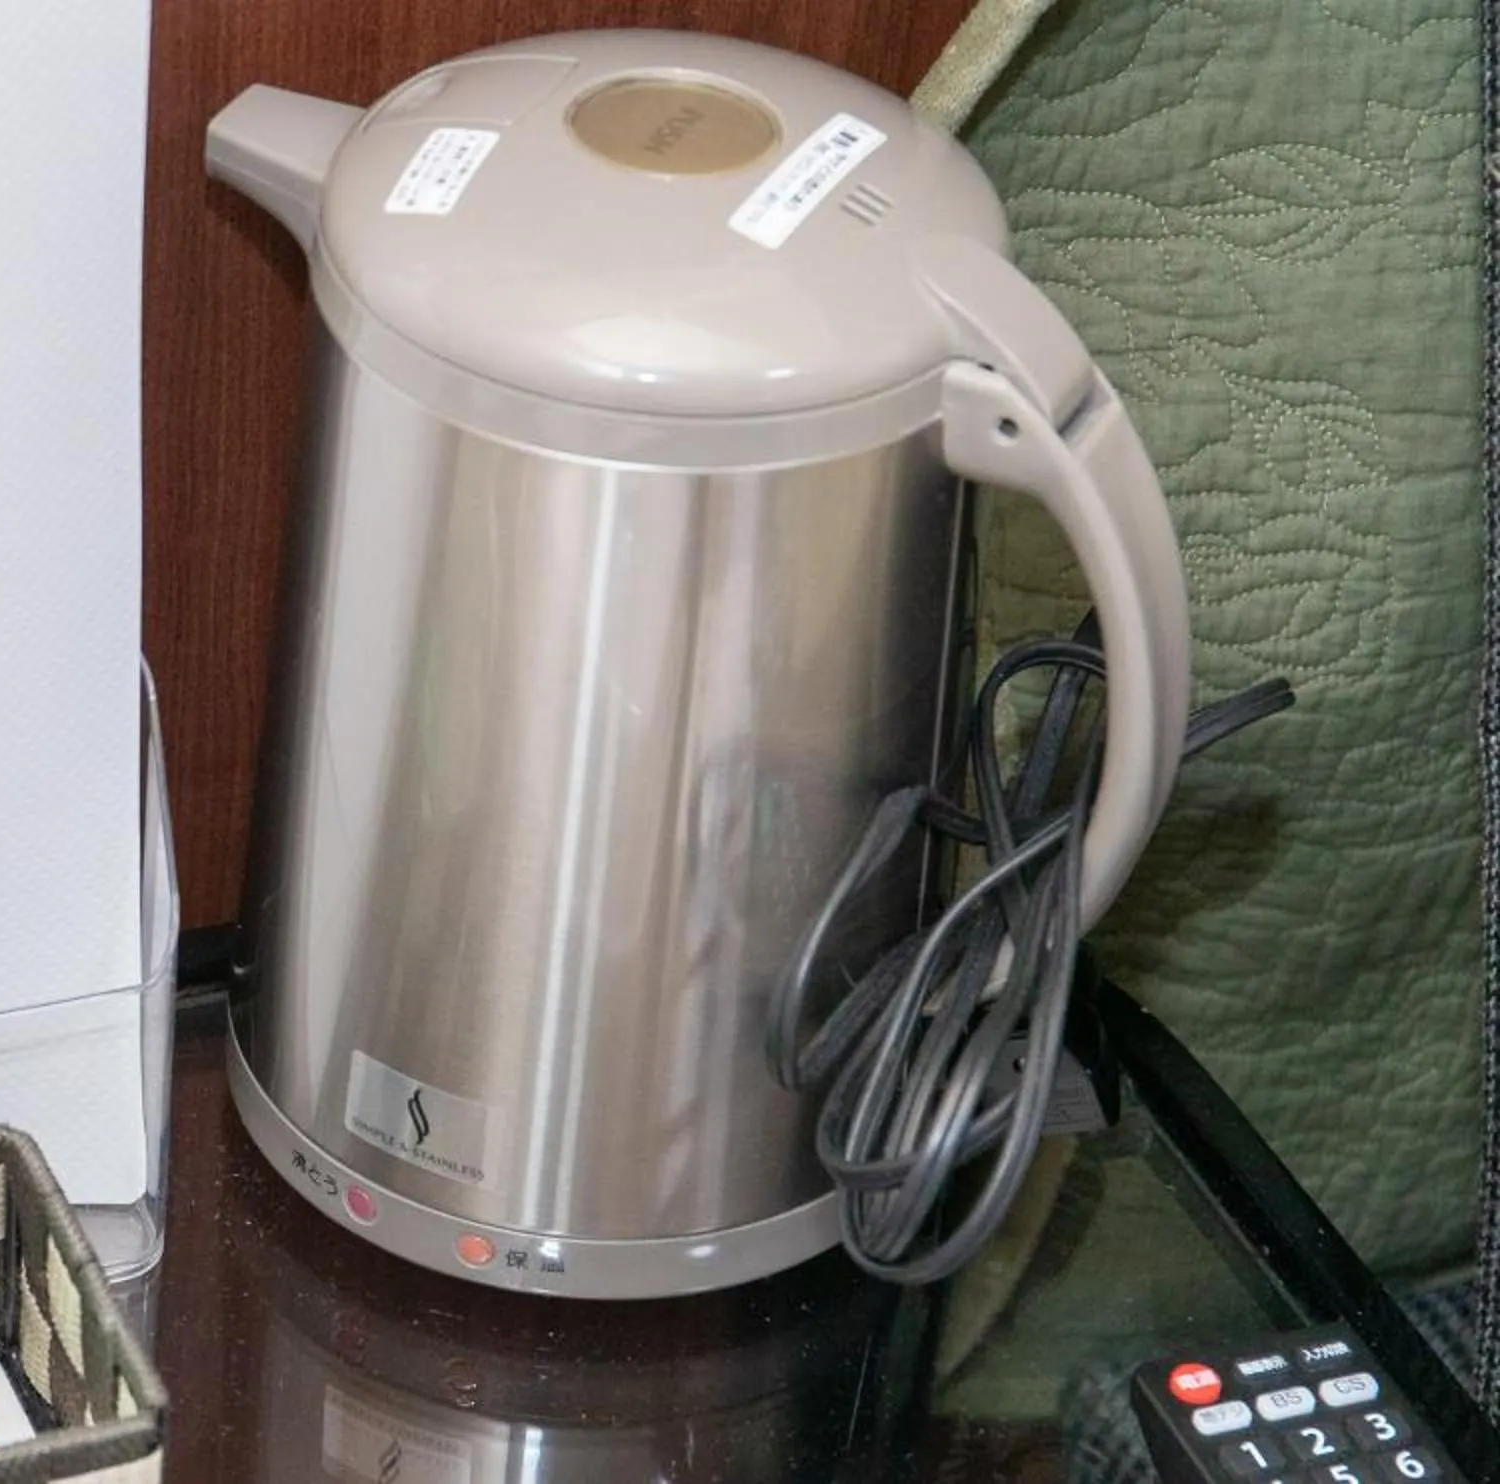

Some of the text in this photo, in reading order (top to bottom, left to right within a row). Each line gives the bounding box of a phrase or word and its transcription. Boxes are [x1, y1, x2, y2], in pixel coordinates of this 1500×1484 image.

[1269, 1389, 1304, 1408] BS
[1363, 1412, 1397, 1441] 3
[1240, 1440, 1268, 1469] 1
[1300, 1427, 1336, 1456] 2
[1395, 1450, 1425, 1479] 6
